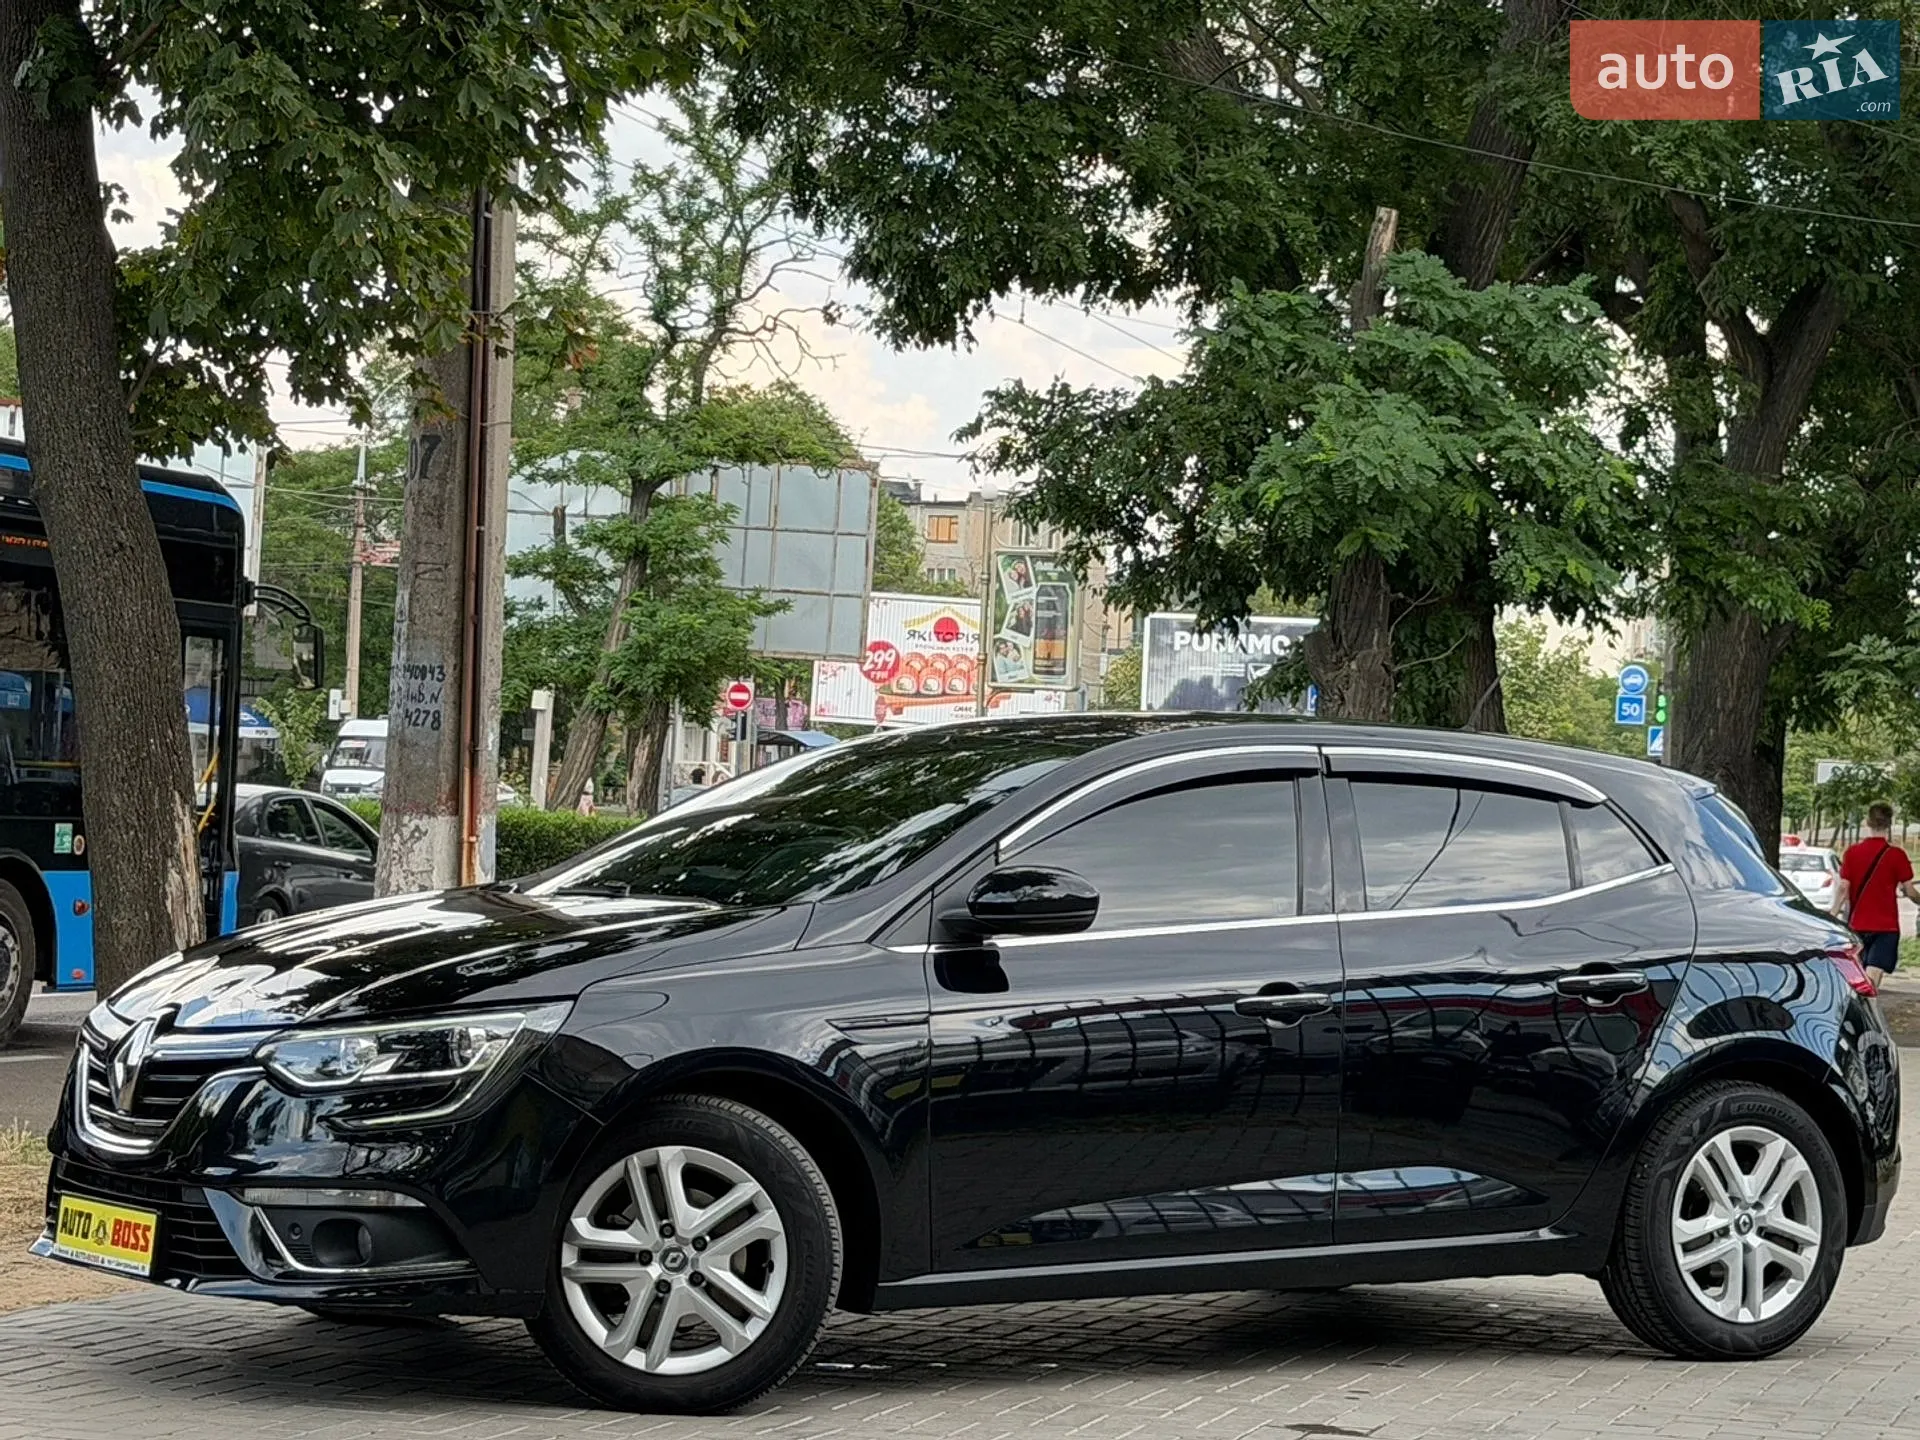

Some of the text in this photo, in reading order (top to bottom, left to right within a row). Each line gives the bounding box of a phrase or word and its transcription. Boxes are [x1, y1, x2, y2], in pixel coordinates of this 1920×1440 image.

[862, 648, 896, 672] 299
[404, 707, 441, 731] 4278
[1621, 702, 1640, 717] 50
[60, 1206, 152, 1253] AUTO BOSS
